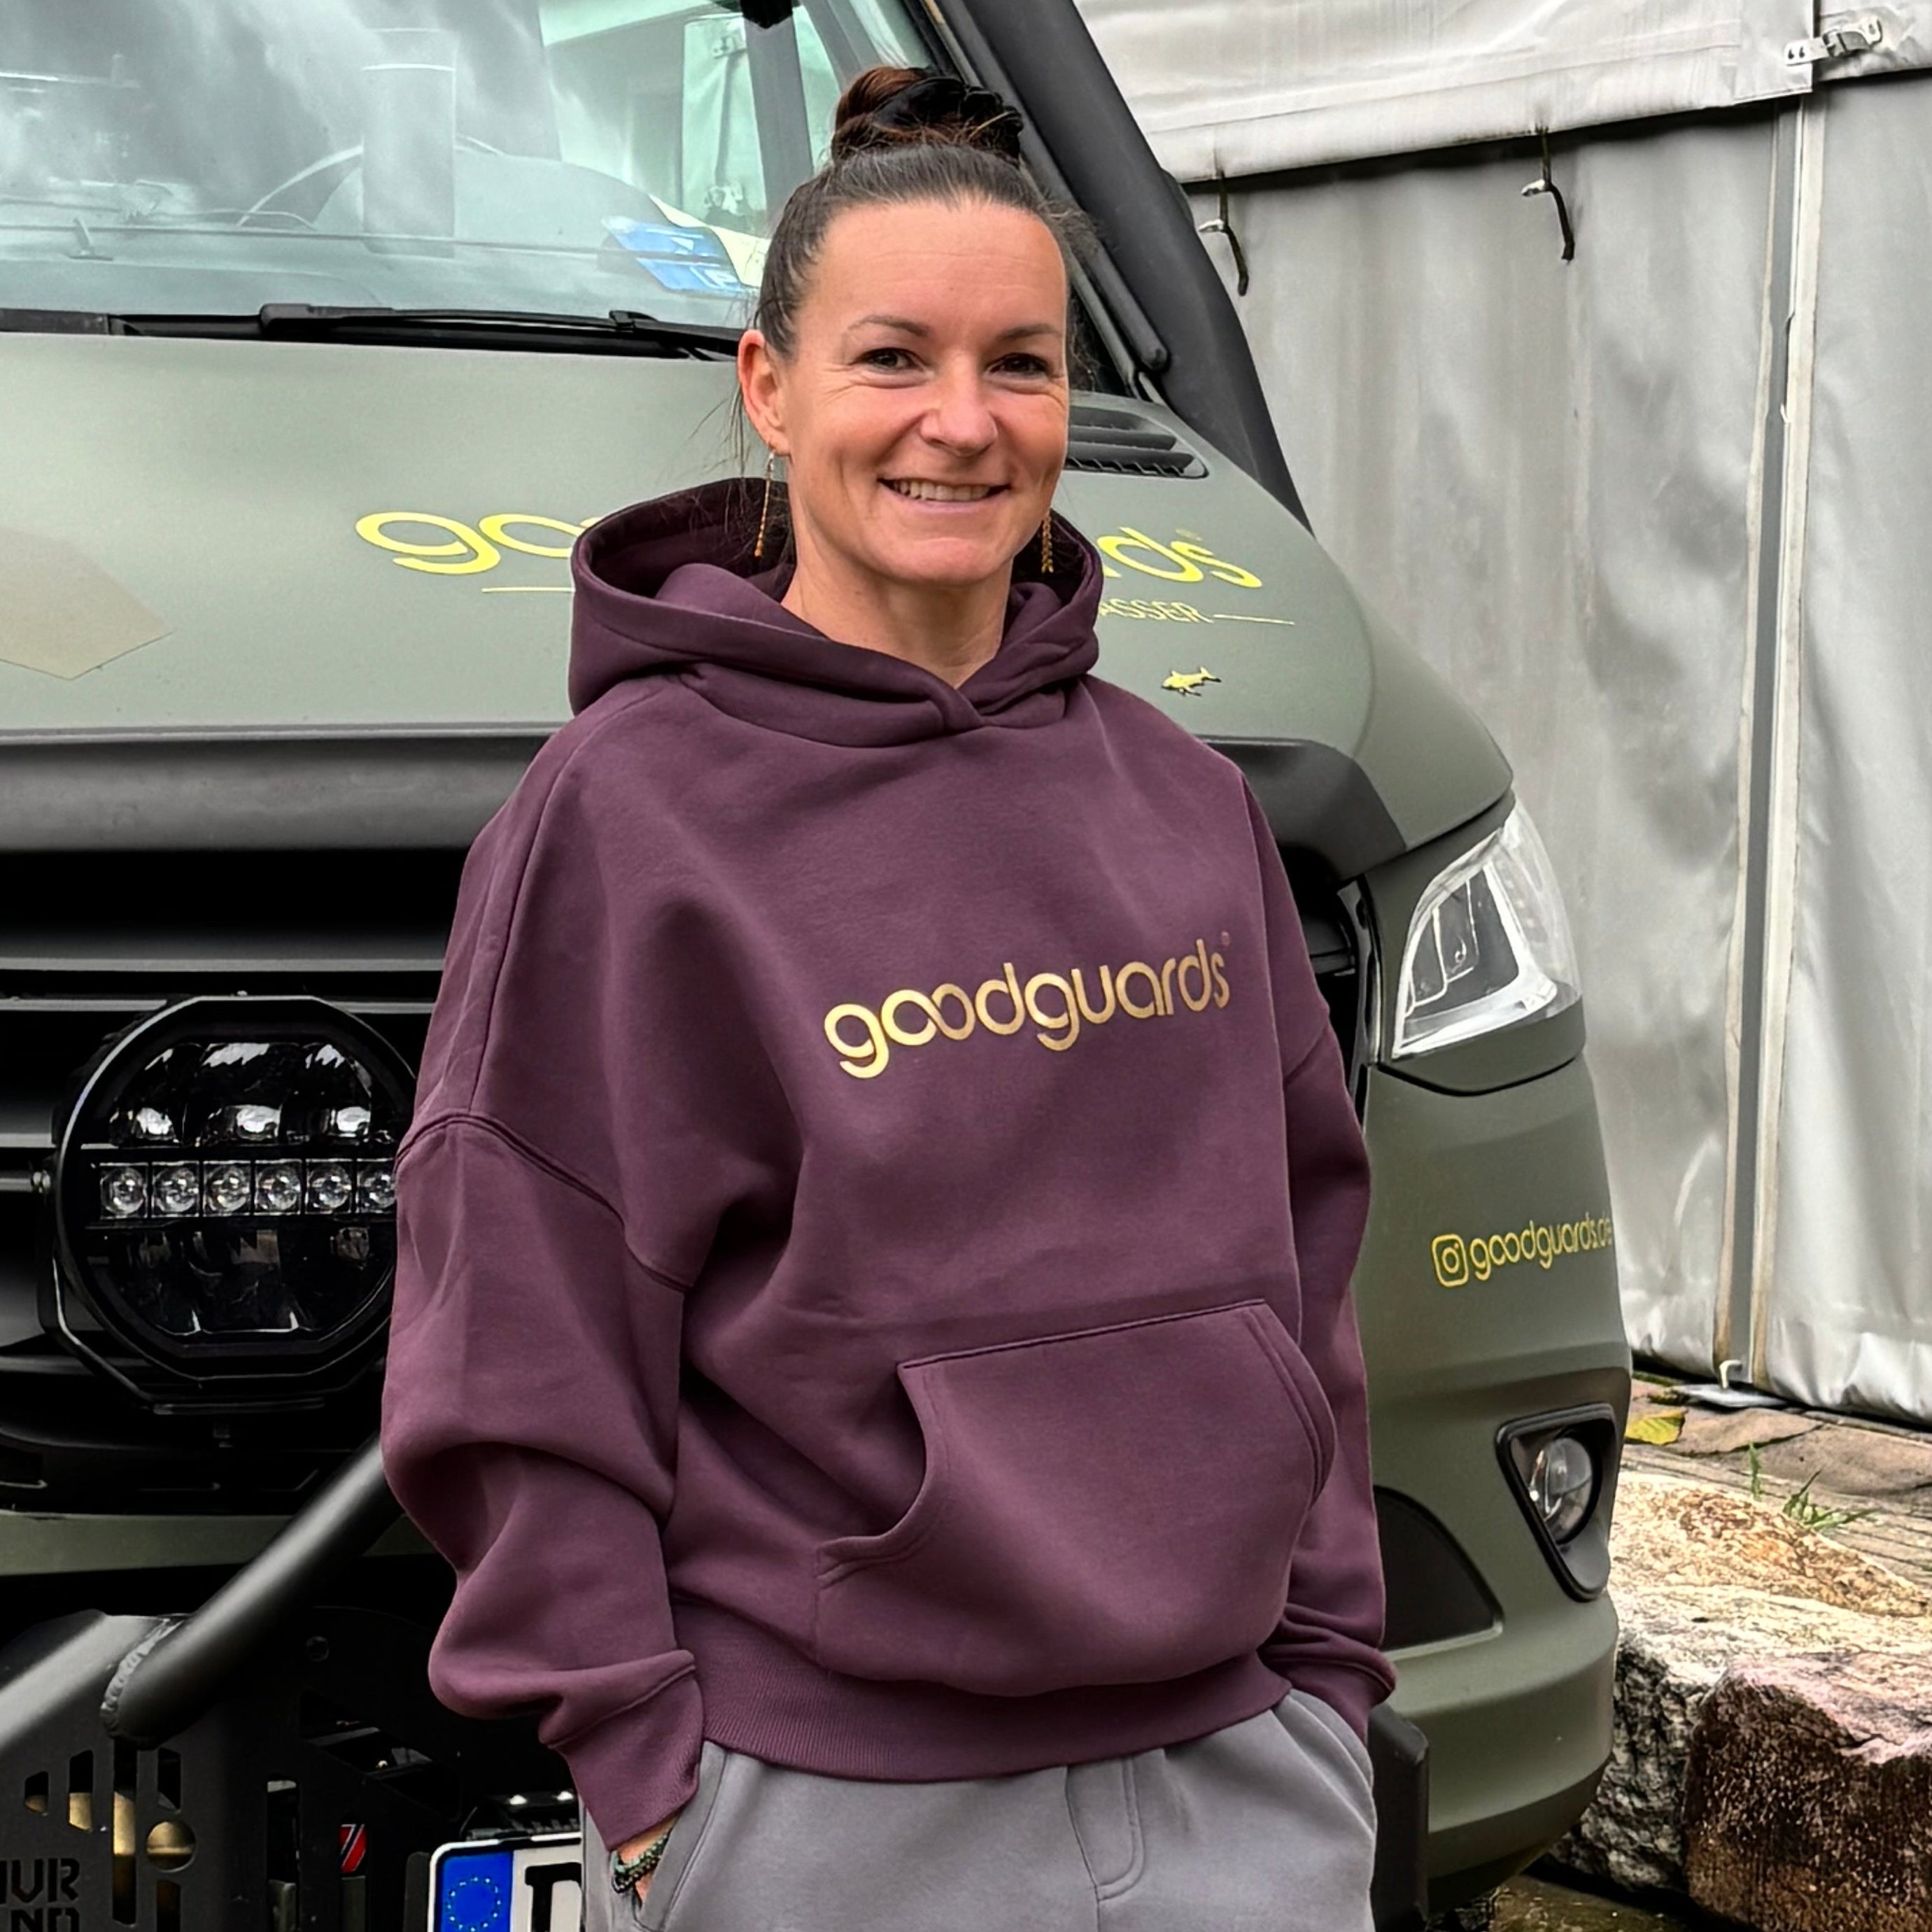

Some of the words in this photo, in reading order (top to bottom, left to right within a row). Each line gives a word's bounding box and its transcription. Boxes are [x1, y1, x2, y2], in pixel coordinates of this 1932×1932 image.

[1099, 598, 1214, 623] ASSER
[824, 938, 1229, 1078] goodguards
[0, 1858, 80, 1904] UR
